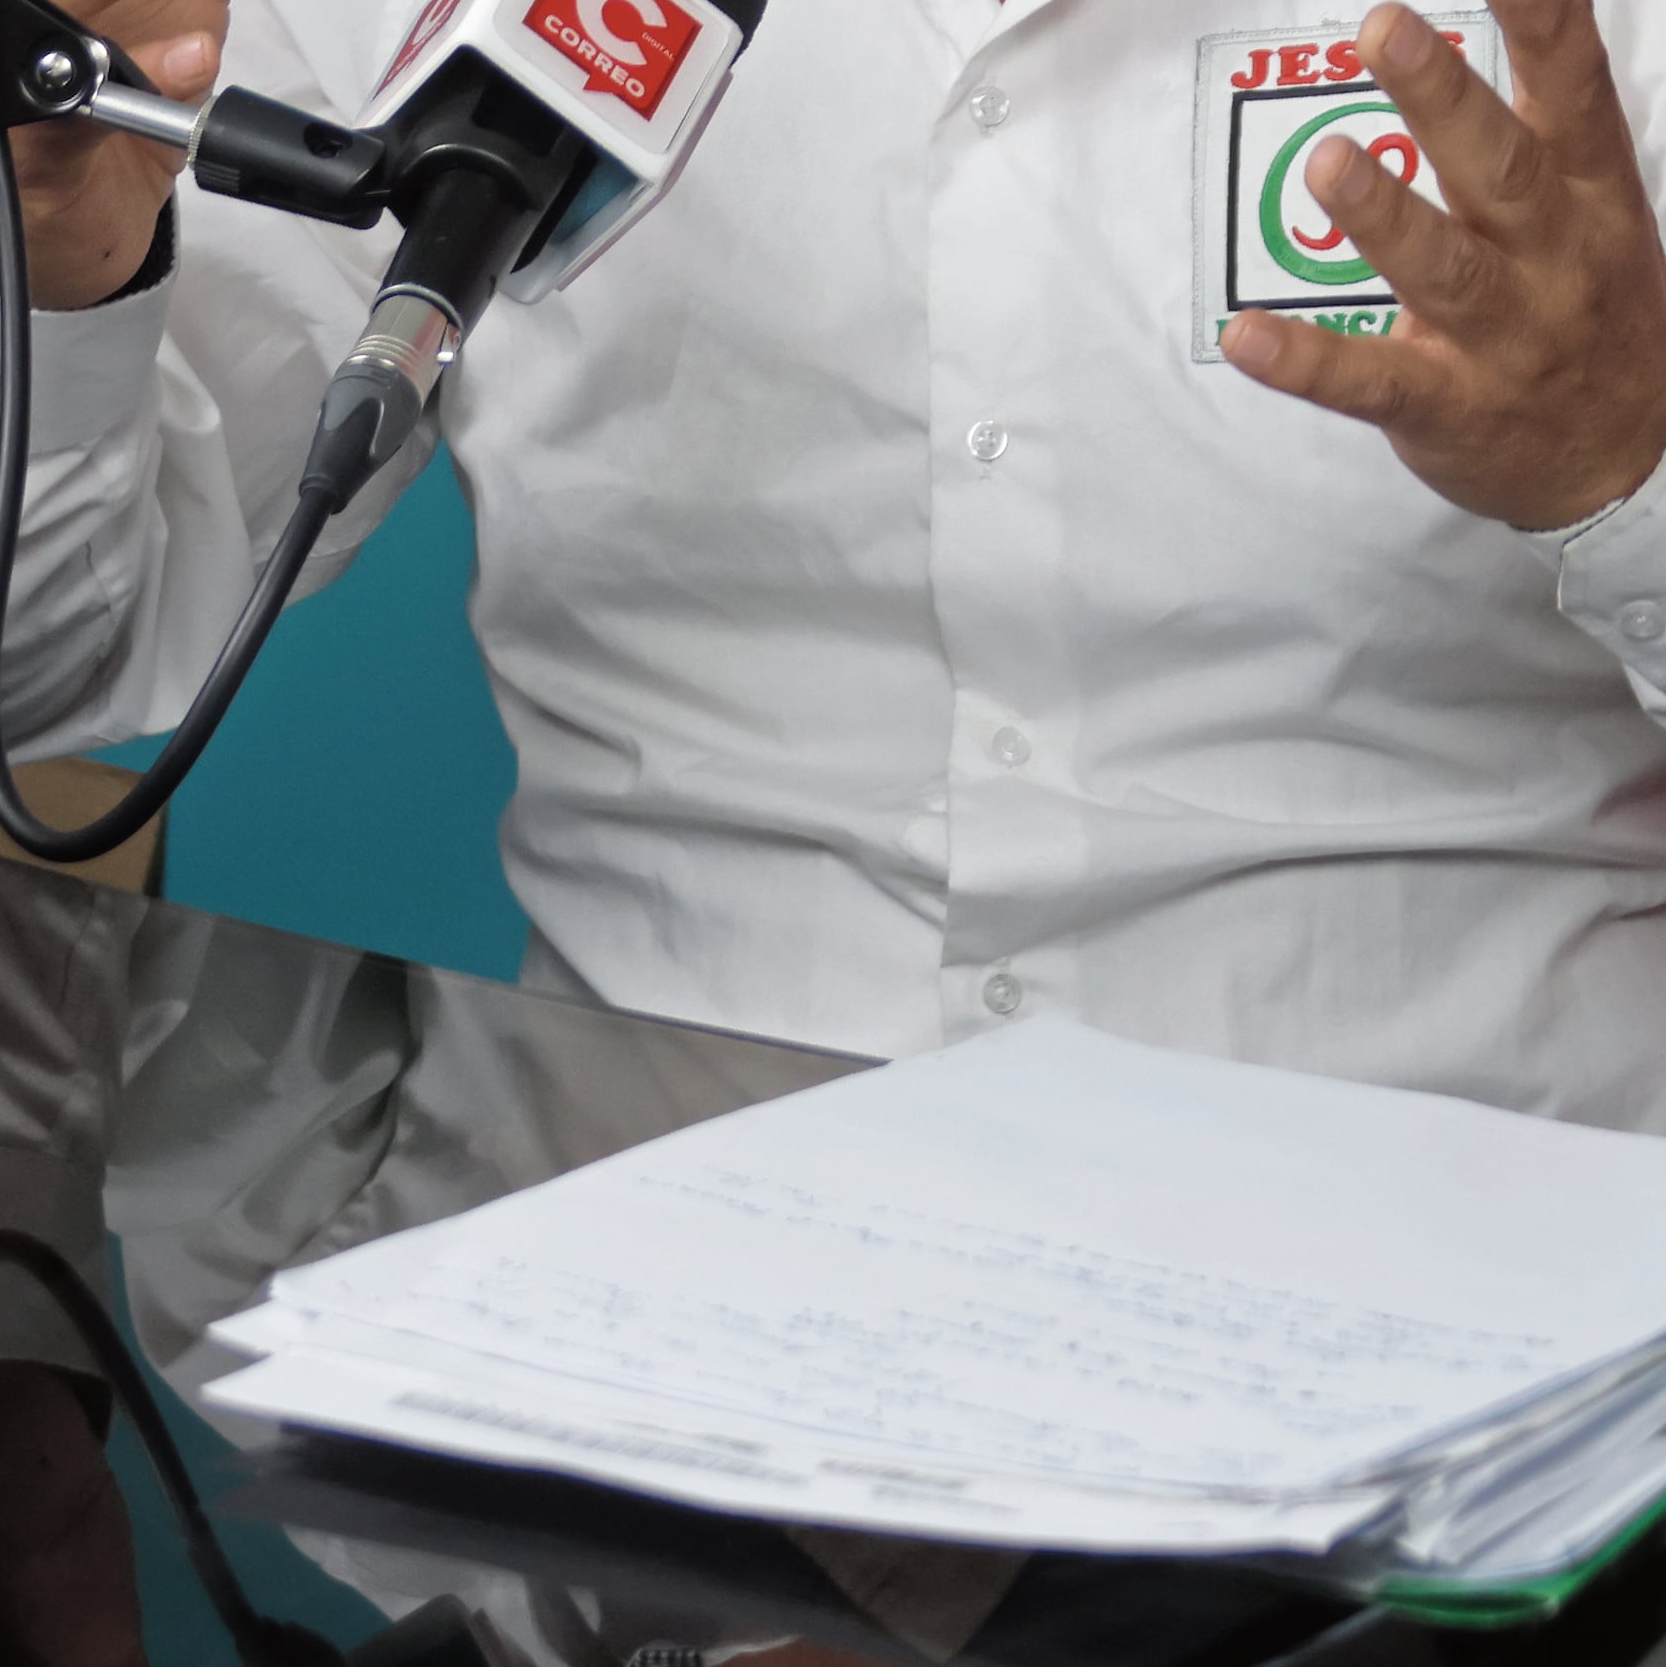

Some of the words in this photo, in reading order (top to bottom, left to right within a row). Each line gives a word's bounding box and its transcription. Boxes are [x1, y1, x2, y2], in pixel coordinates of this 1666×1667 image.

[544, 14, 646, 98] CORREO
[641, 31, 675, 61] DIGITAL
[1231, 31, 1465, 89] JES
